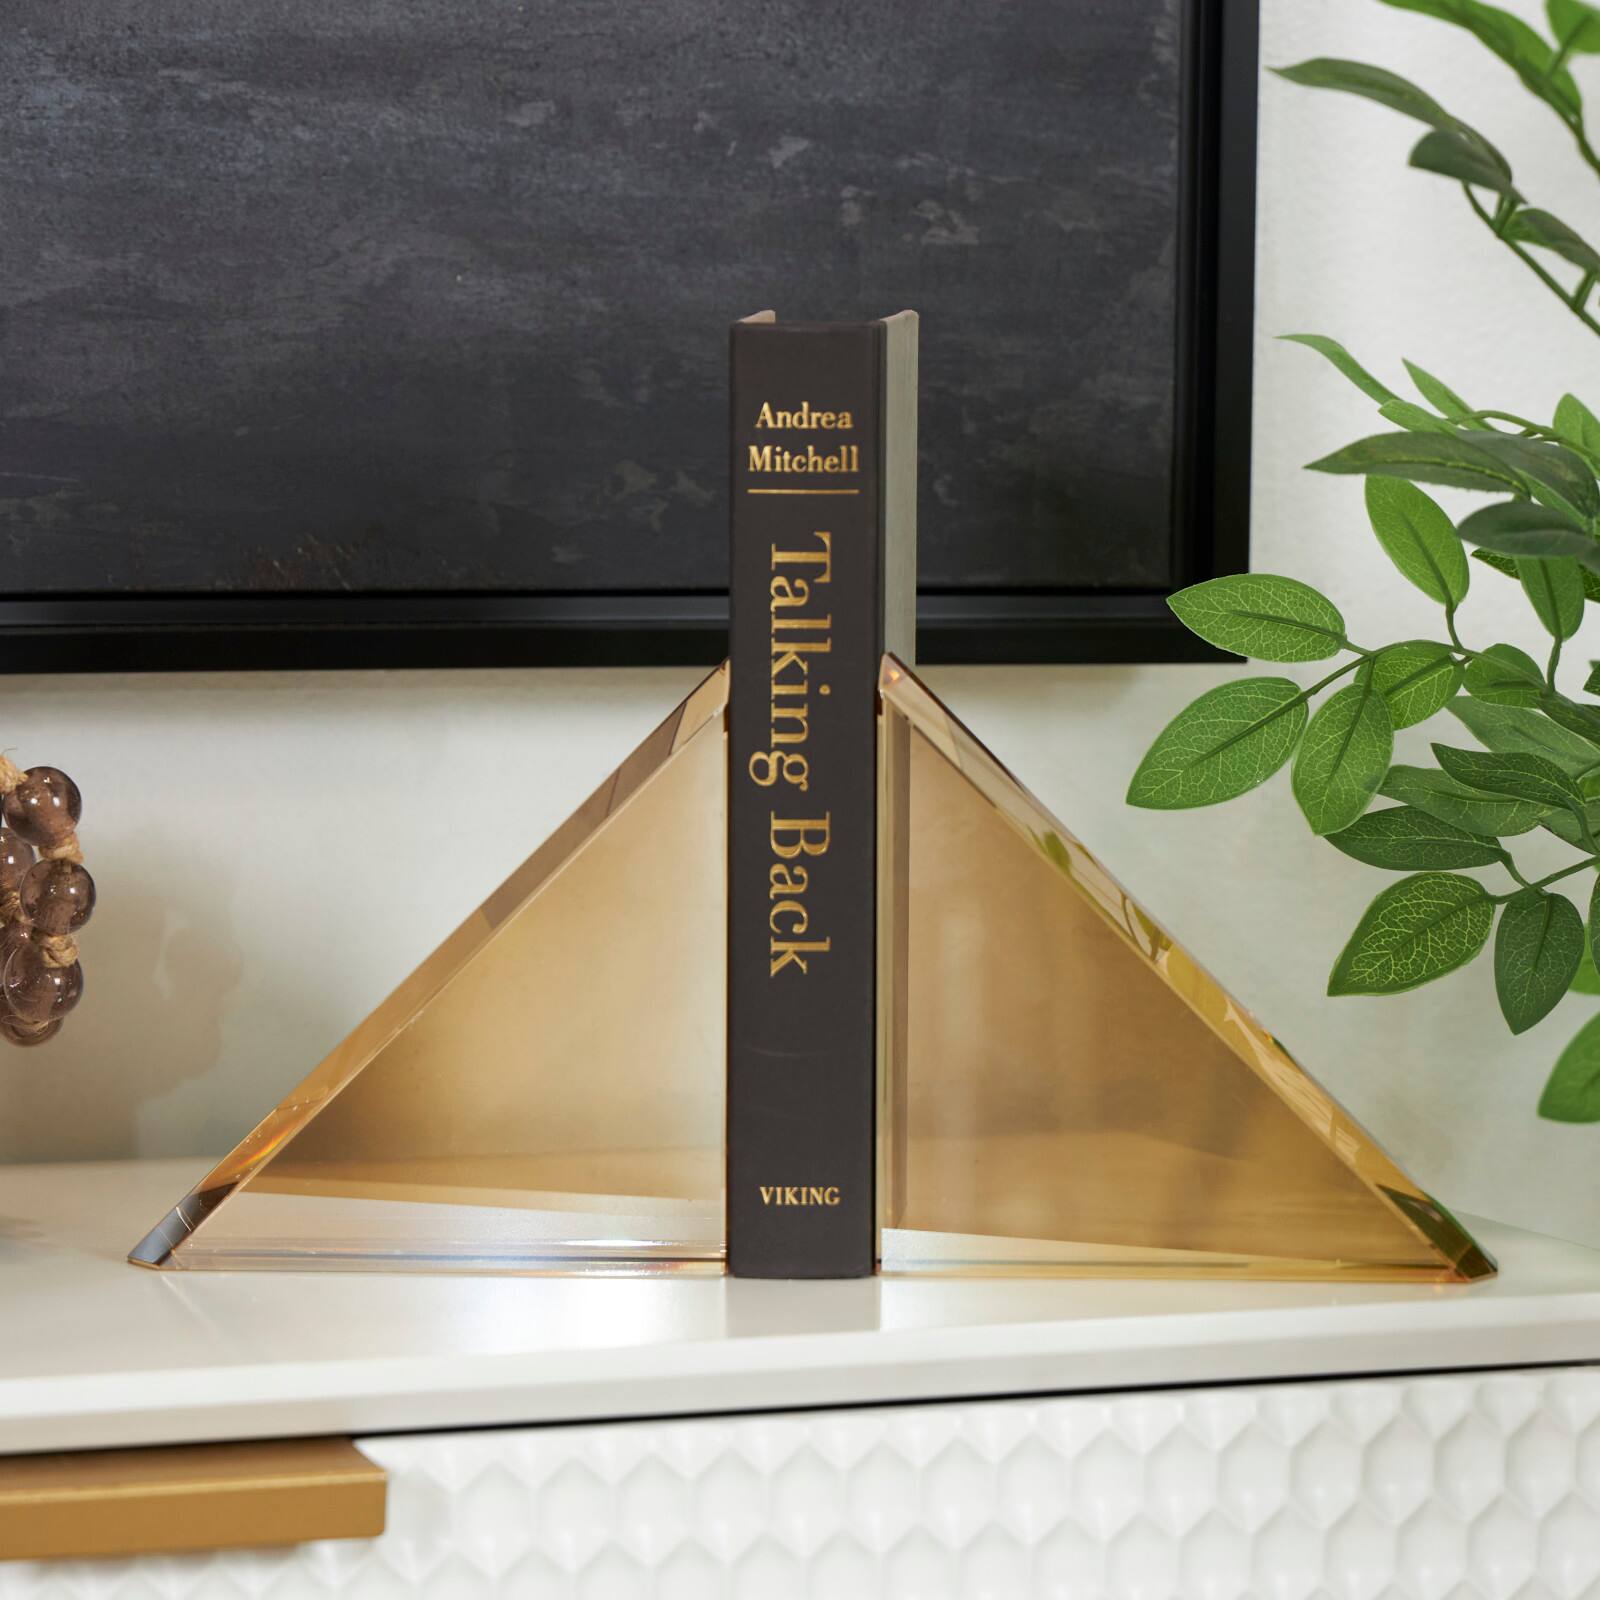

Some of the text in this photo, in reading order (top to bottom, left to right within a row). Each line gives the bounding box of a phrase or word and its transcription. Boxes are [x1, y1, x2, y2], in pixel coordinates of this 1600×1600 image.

[755, 401, 853, 430] Andrea
[748, 444, 861, 474] Mitchell
[748, 531, 833, 976] Talking Back
[760, 1186, 841, 1206] VIKING
